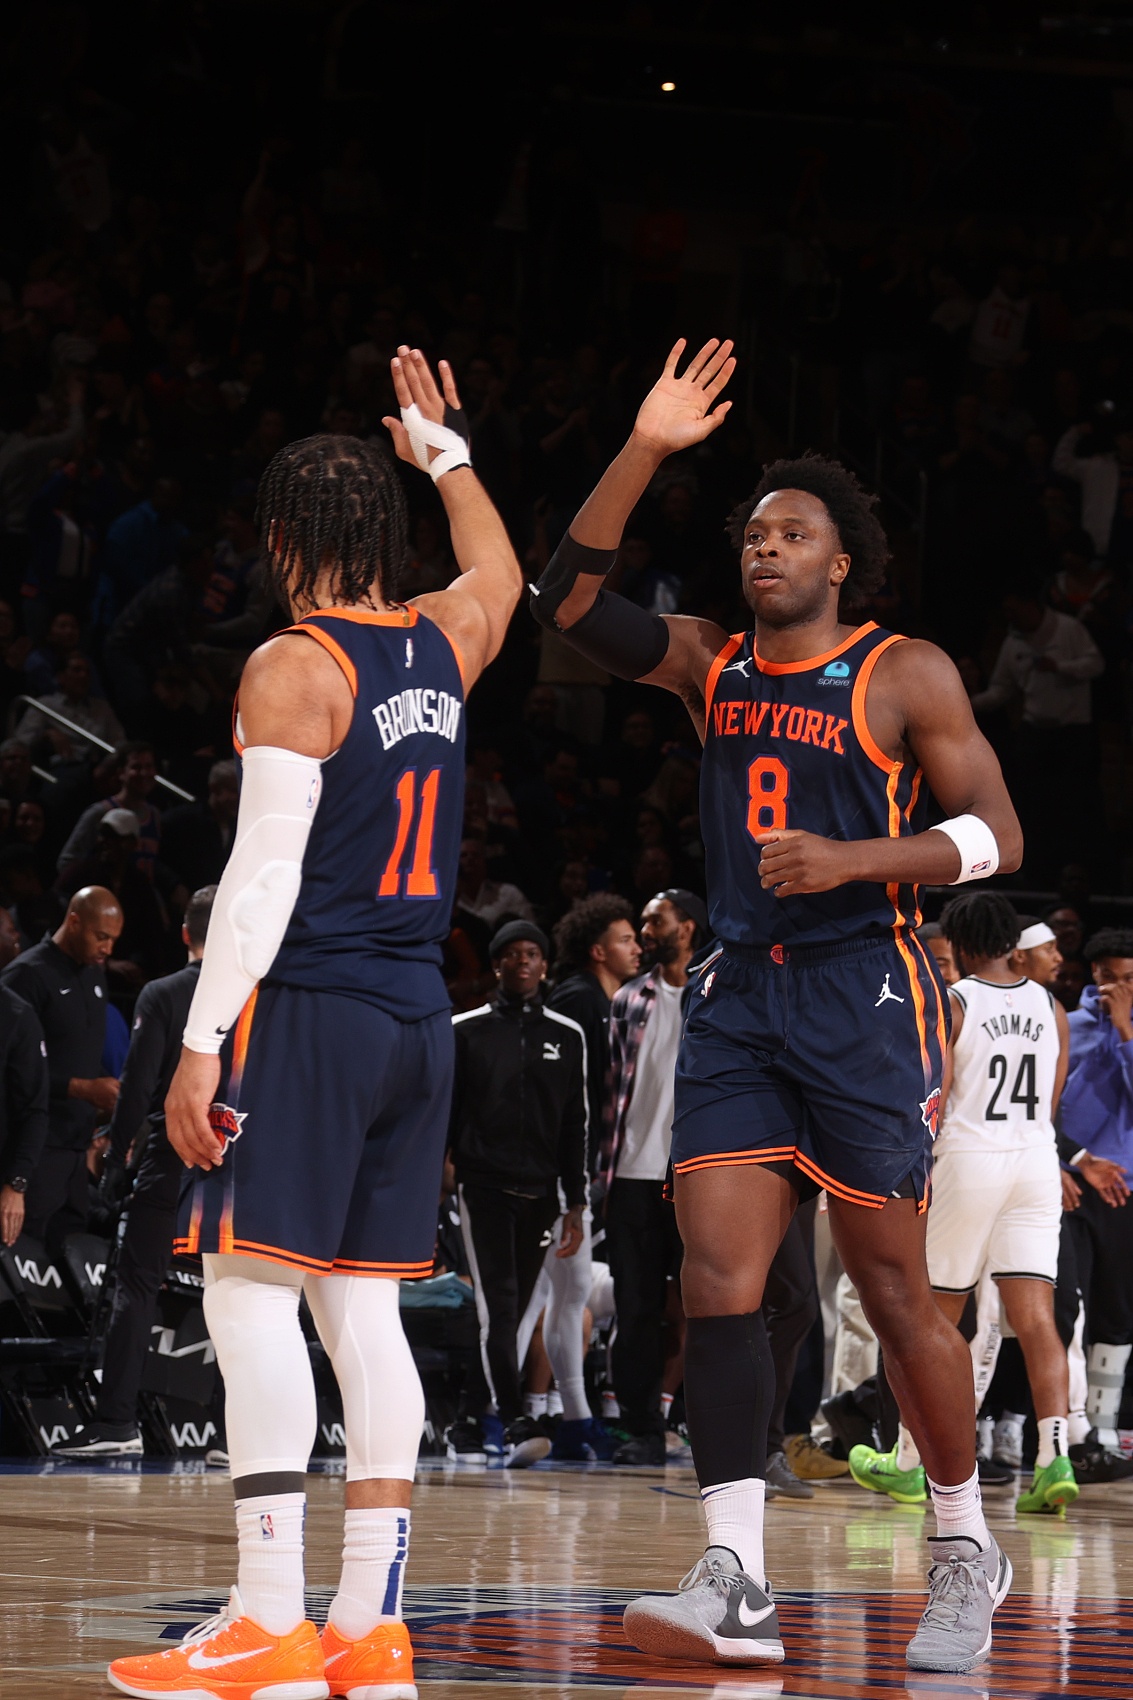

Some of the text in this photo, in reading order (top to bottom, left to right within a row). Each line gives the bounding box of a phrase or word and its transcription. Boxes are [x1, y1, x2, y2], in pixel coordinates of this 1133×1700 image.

[817, 677, 850, 687] sphere
[746, 753, 791, 843] 8
[376, 765, 443, 900] 11
[981, 1014, 1044, 1042] THOMAS
[985, 1054, 1039, 1121] 24
